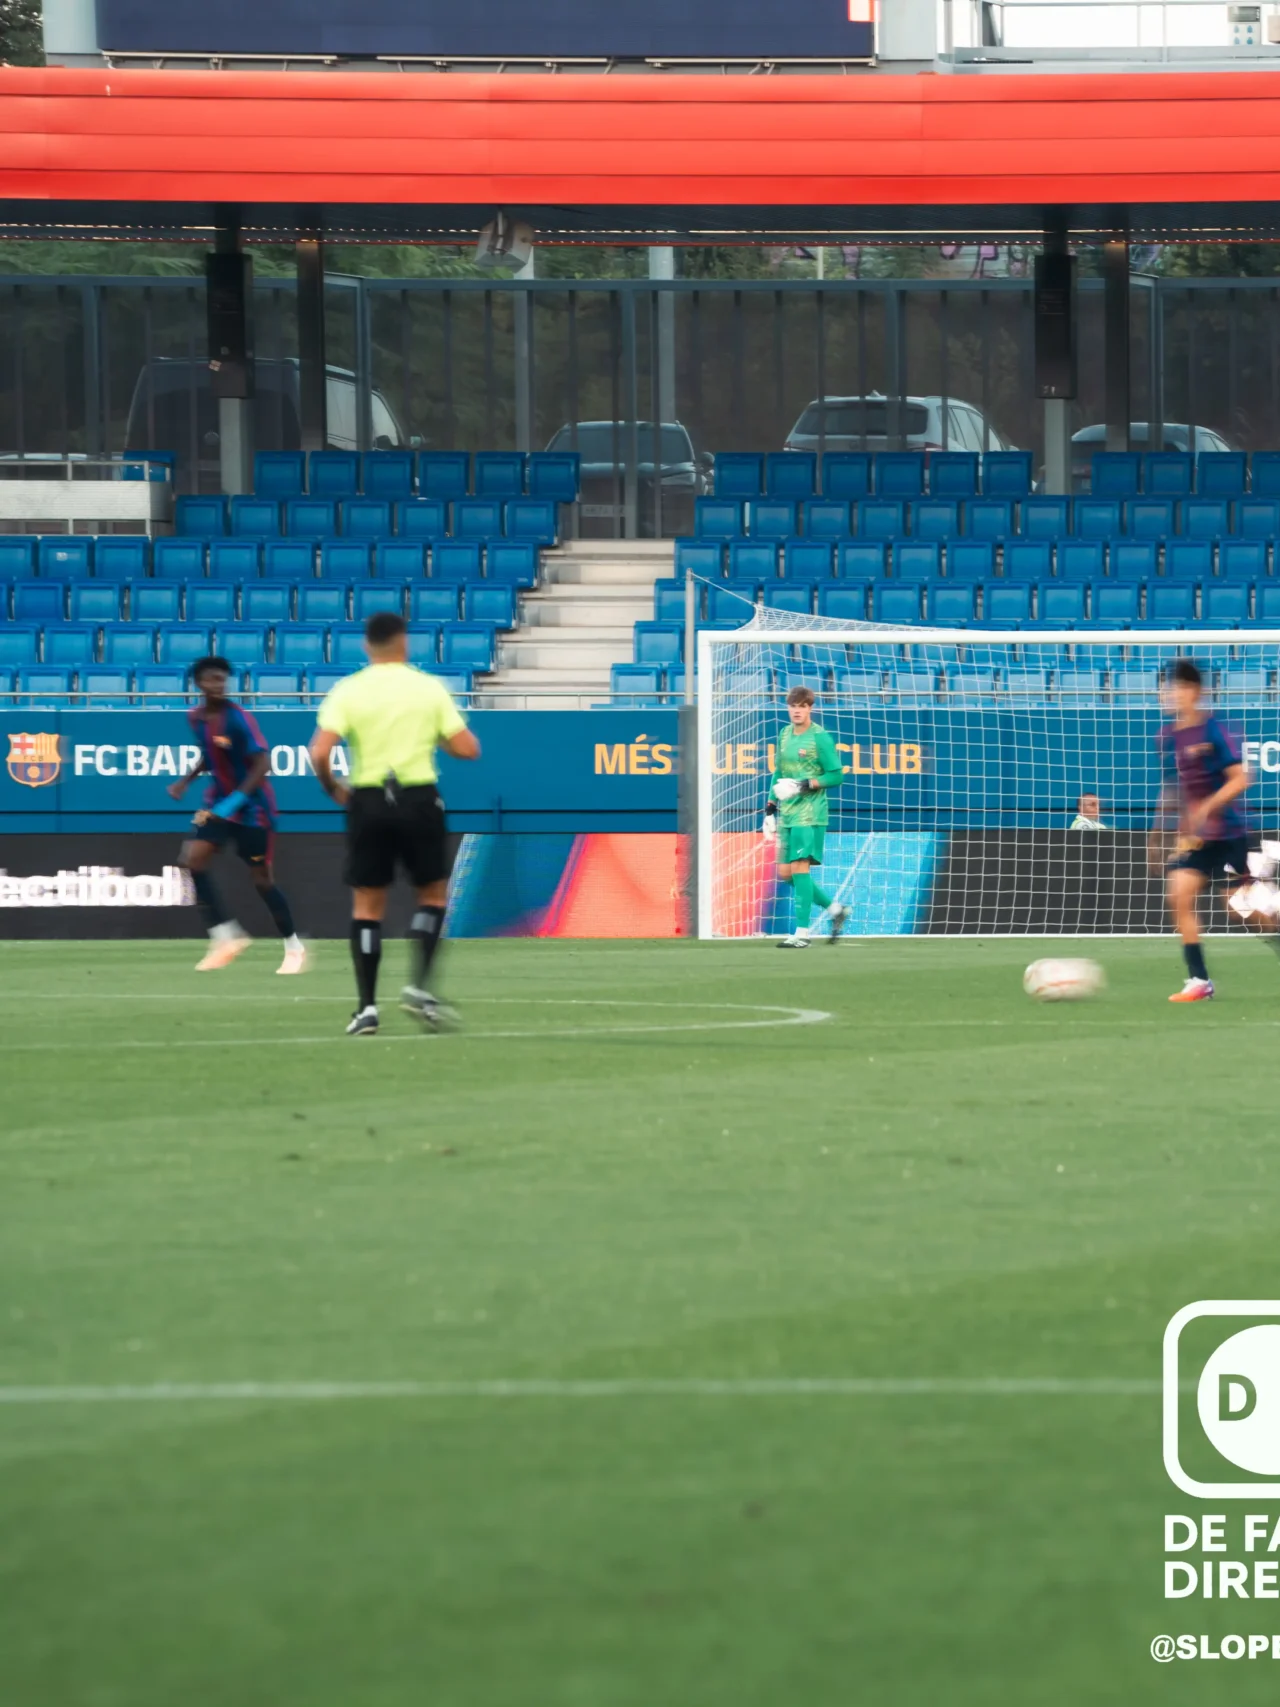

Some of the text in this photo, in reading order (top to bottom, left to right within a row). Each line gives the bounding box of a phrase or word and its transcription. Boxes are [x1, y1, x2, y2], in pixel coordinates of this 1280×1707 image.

[74, 744, 350, 776] FC BARONA
[594, 733, 673, 775] MÉS
